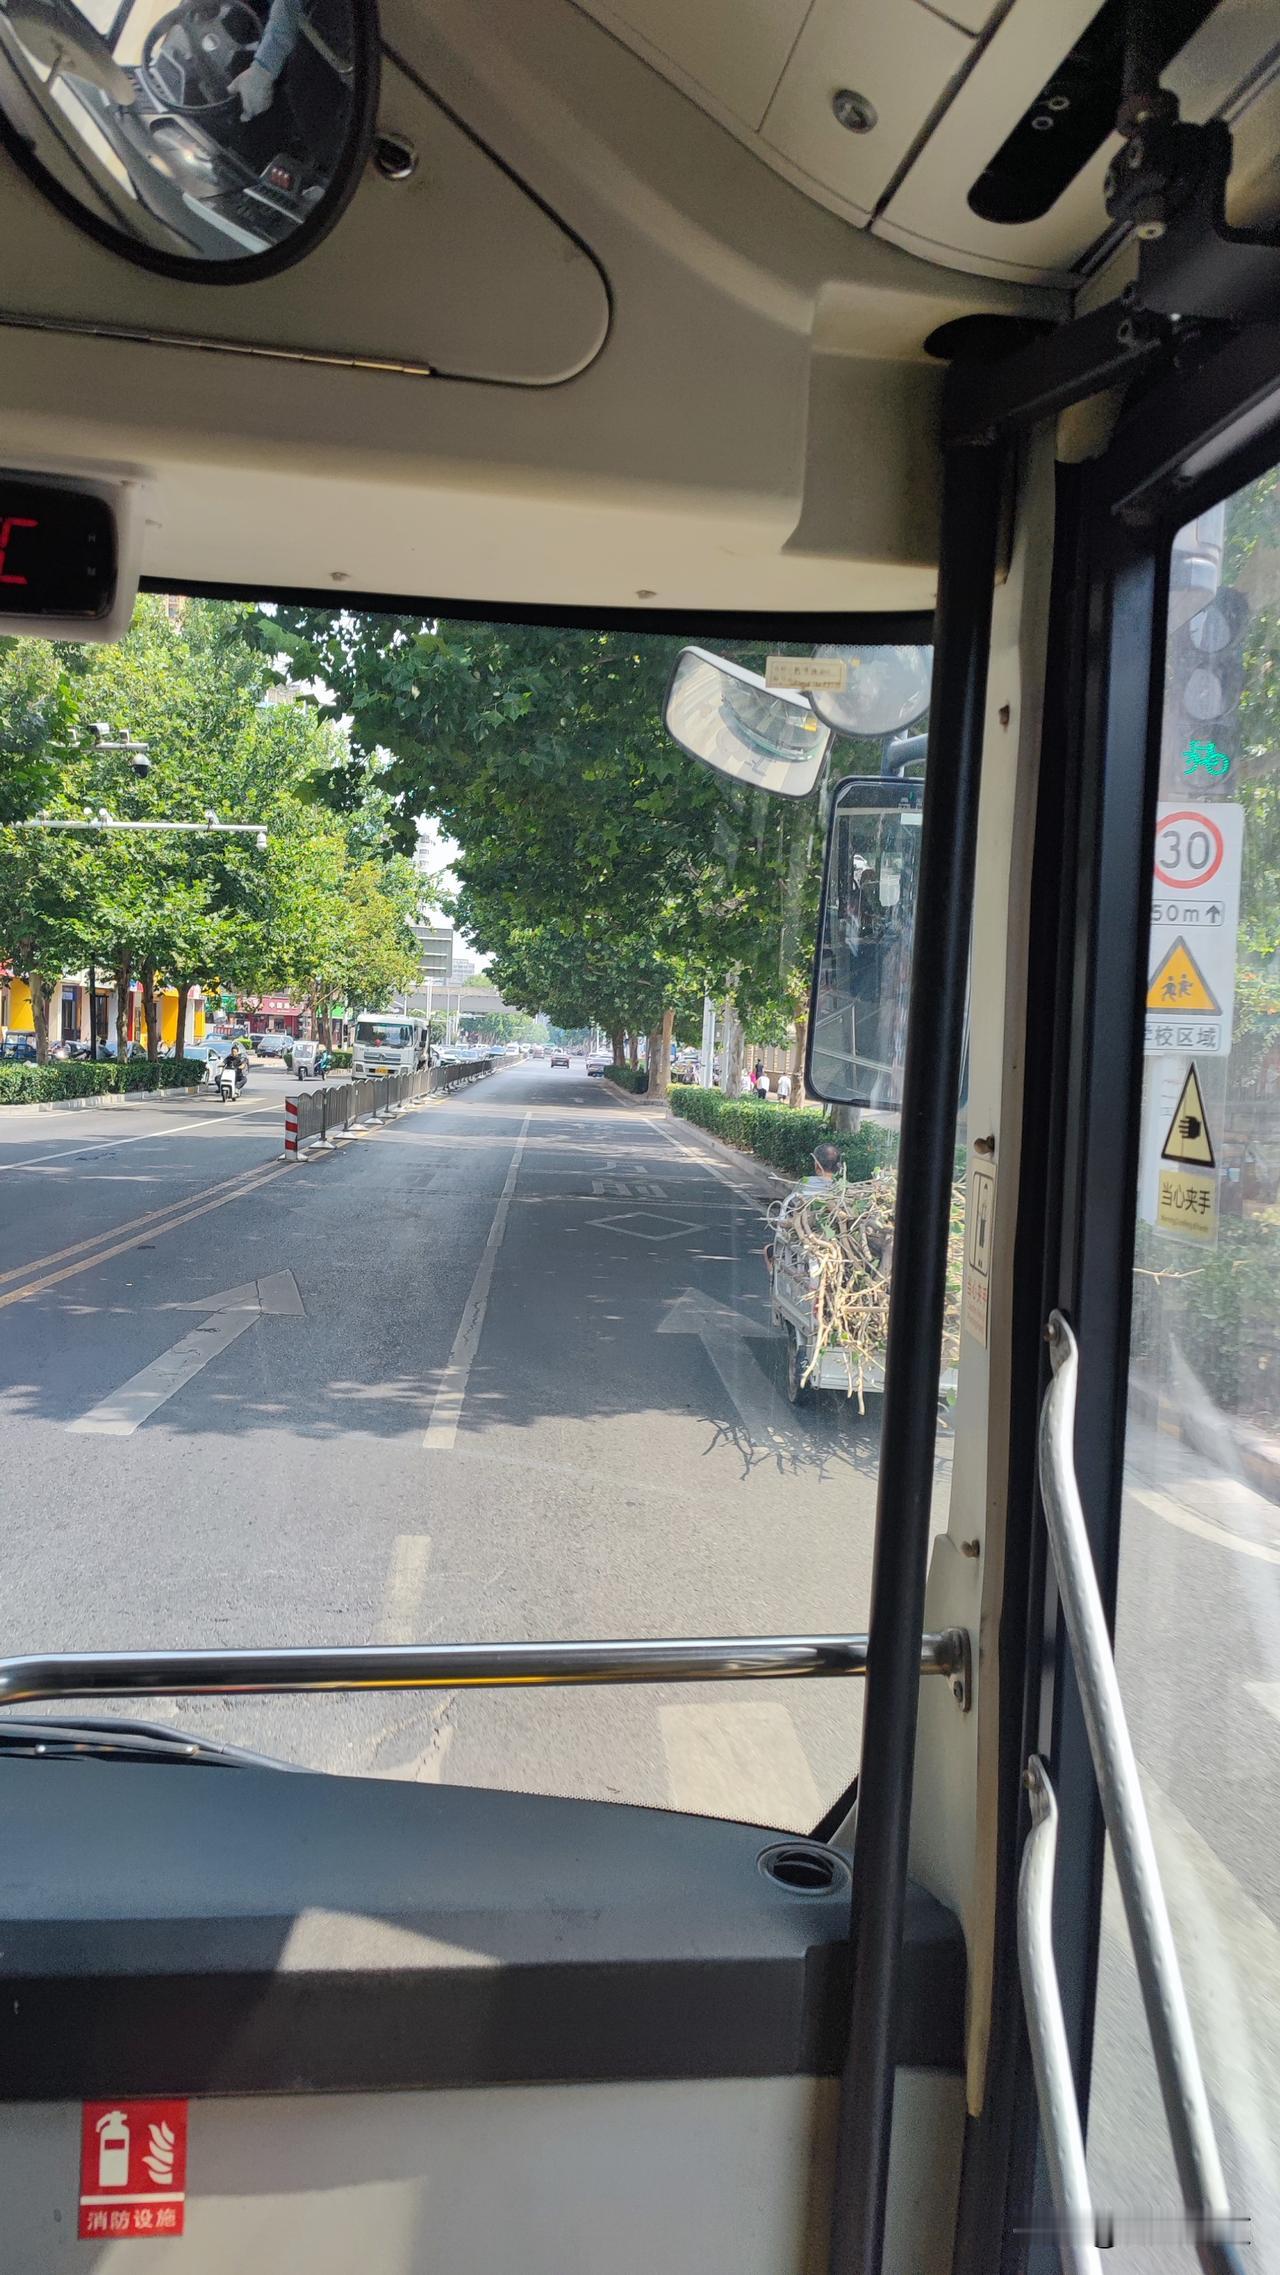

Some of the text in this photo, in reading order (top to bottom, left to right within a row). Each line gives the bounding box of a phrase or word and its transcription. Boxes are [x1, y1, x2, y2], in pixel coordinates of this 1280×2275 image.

[1160, 830, 1210, 870] 30
[1161, 1182, 1211, 1215] 当心夹手
[87, 2208, 177, 2231] 消防设施
